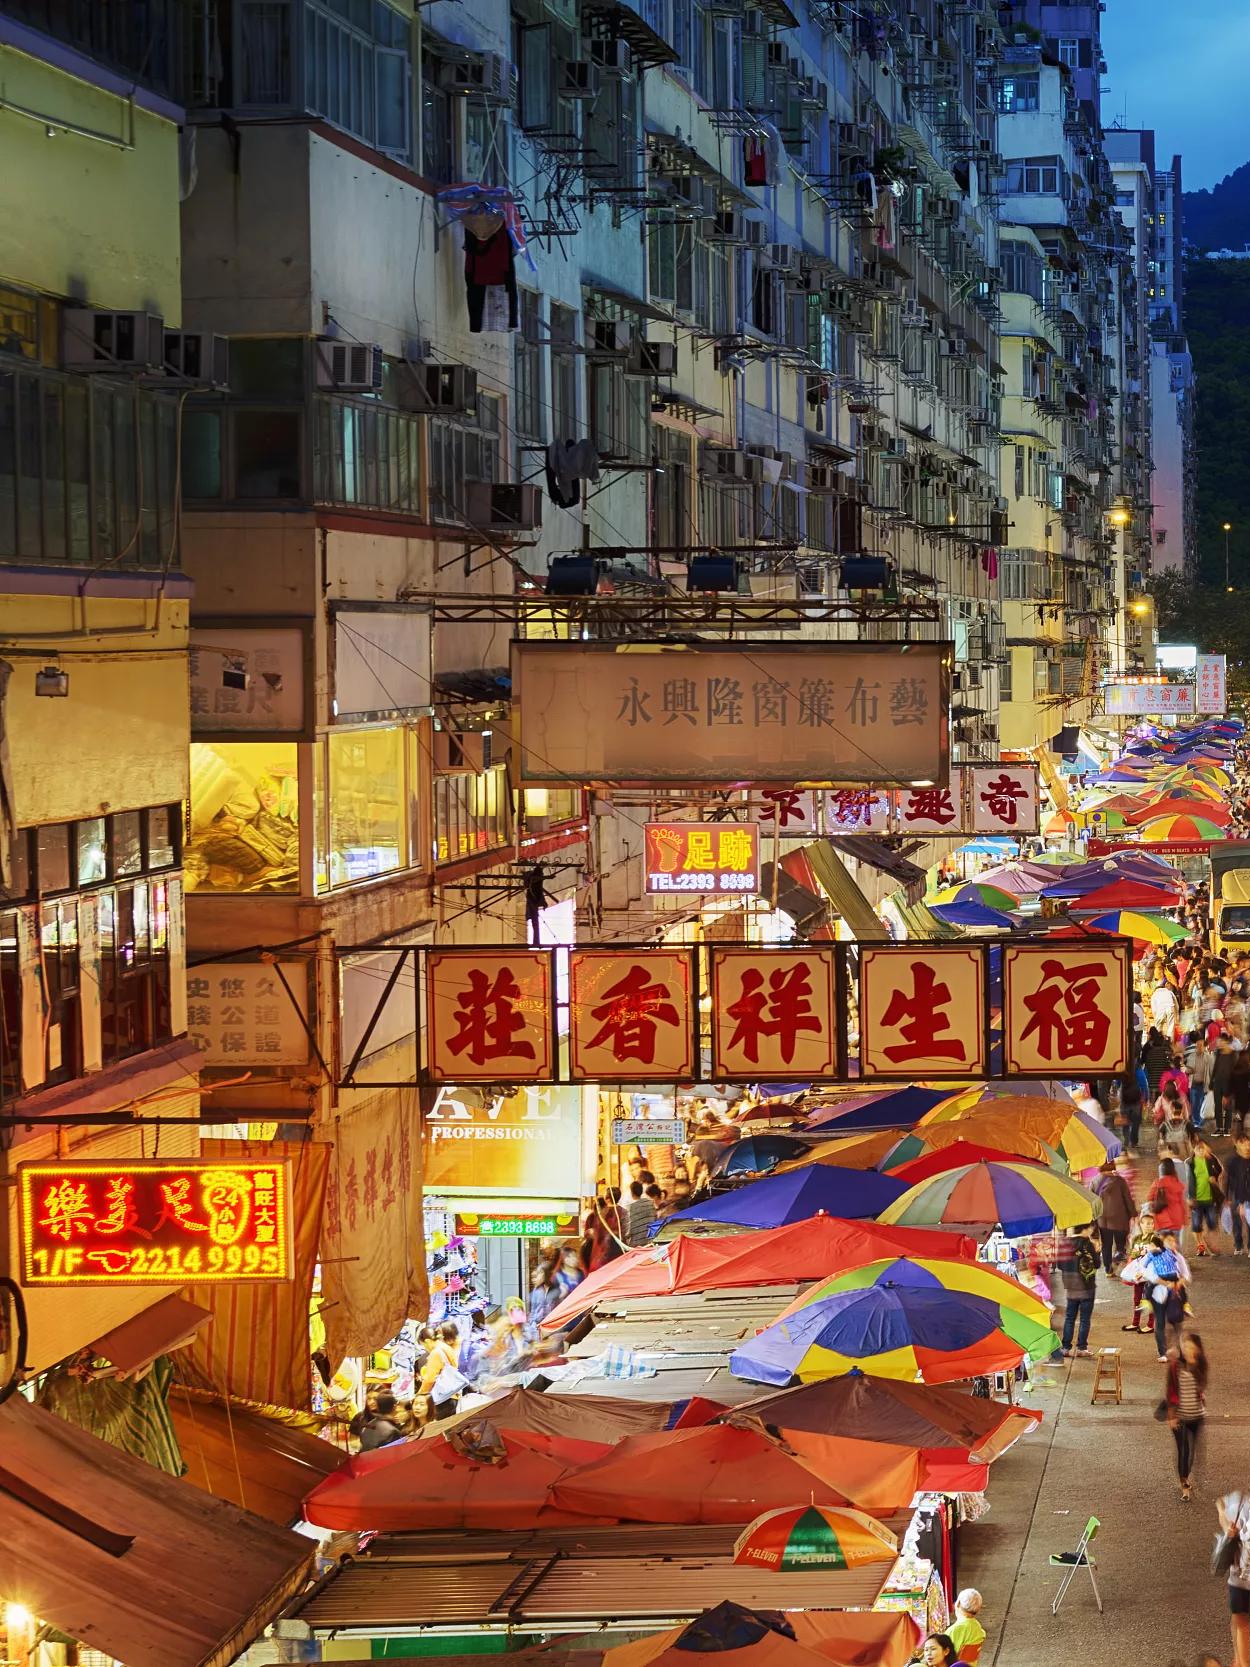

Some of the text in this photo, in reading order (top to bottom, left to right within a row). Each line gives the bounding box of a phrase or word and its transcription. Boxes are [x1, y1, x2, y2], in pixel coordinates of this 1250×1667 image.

[615, 675, 930, 728] 永興隆窗簾布藝
[682, 829, 753, 871] 足跡
[33, 1245, 280, 1277] 1/F 2214 9995
[746, 1547, 779, 1563] 7-ELEVEN
